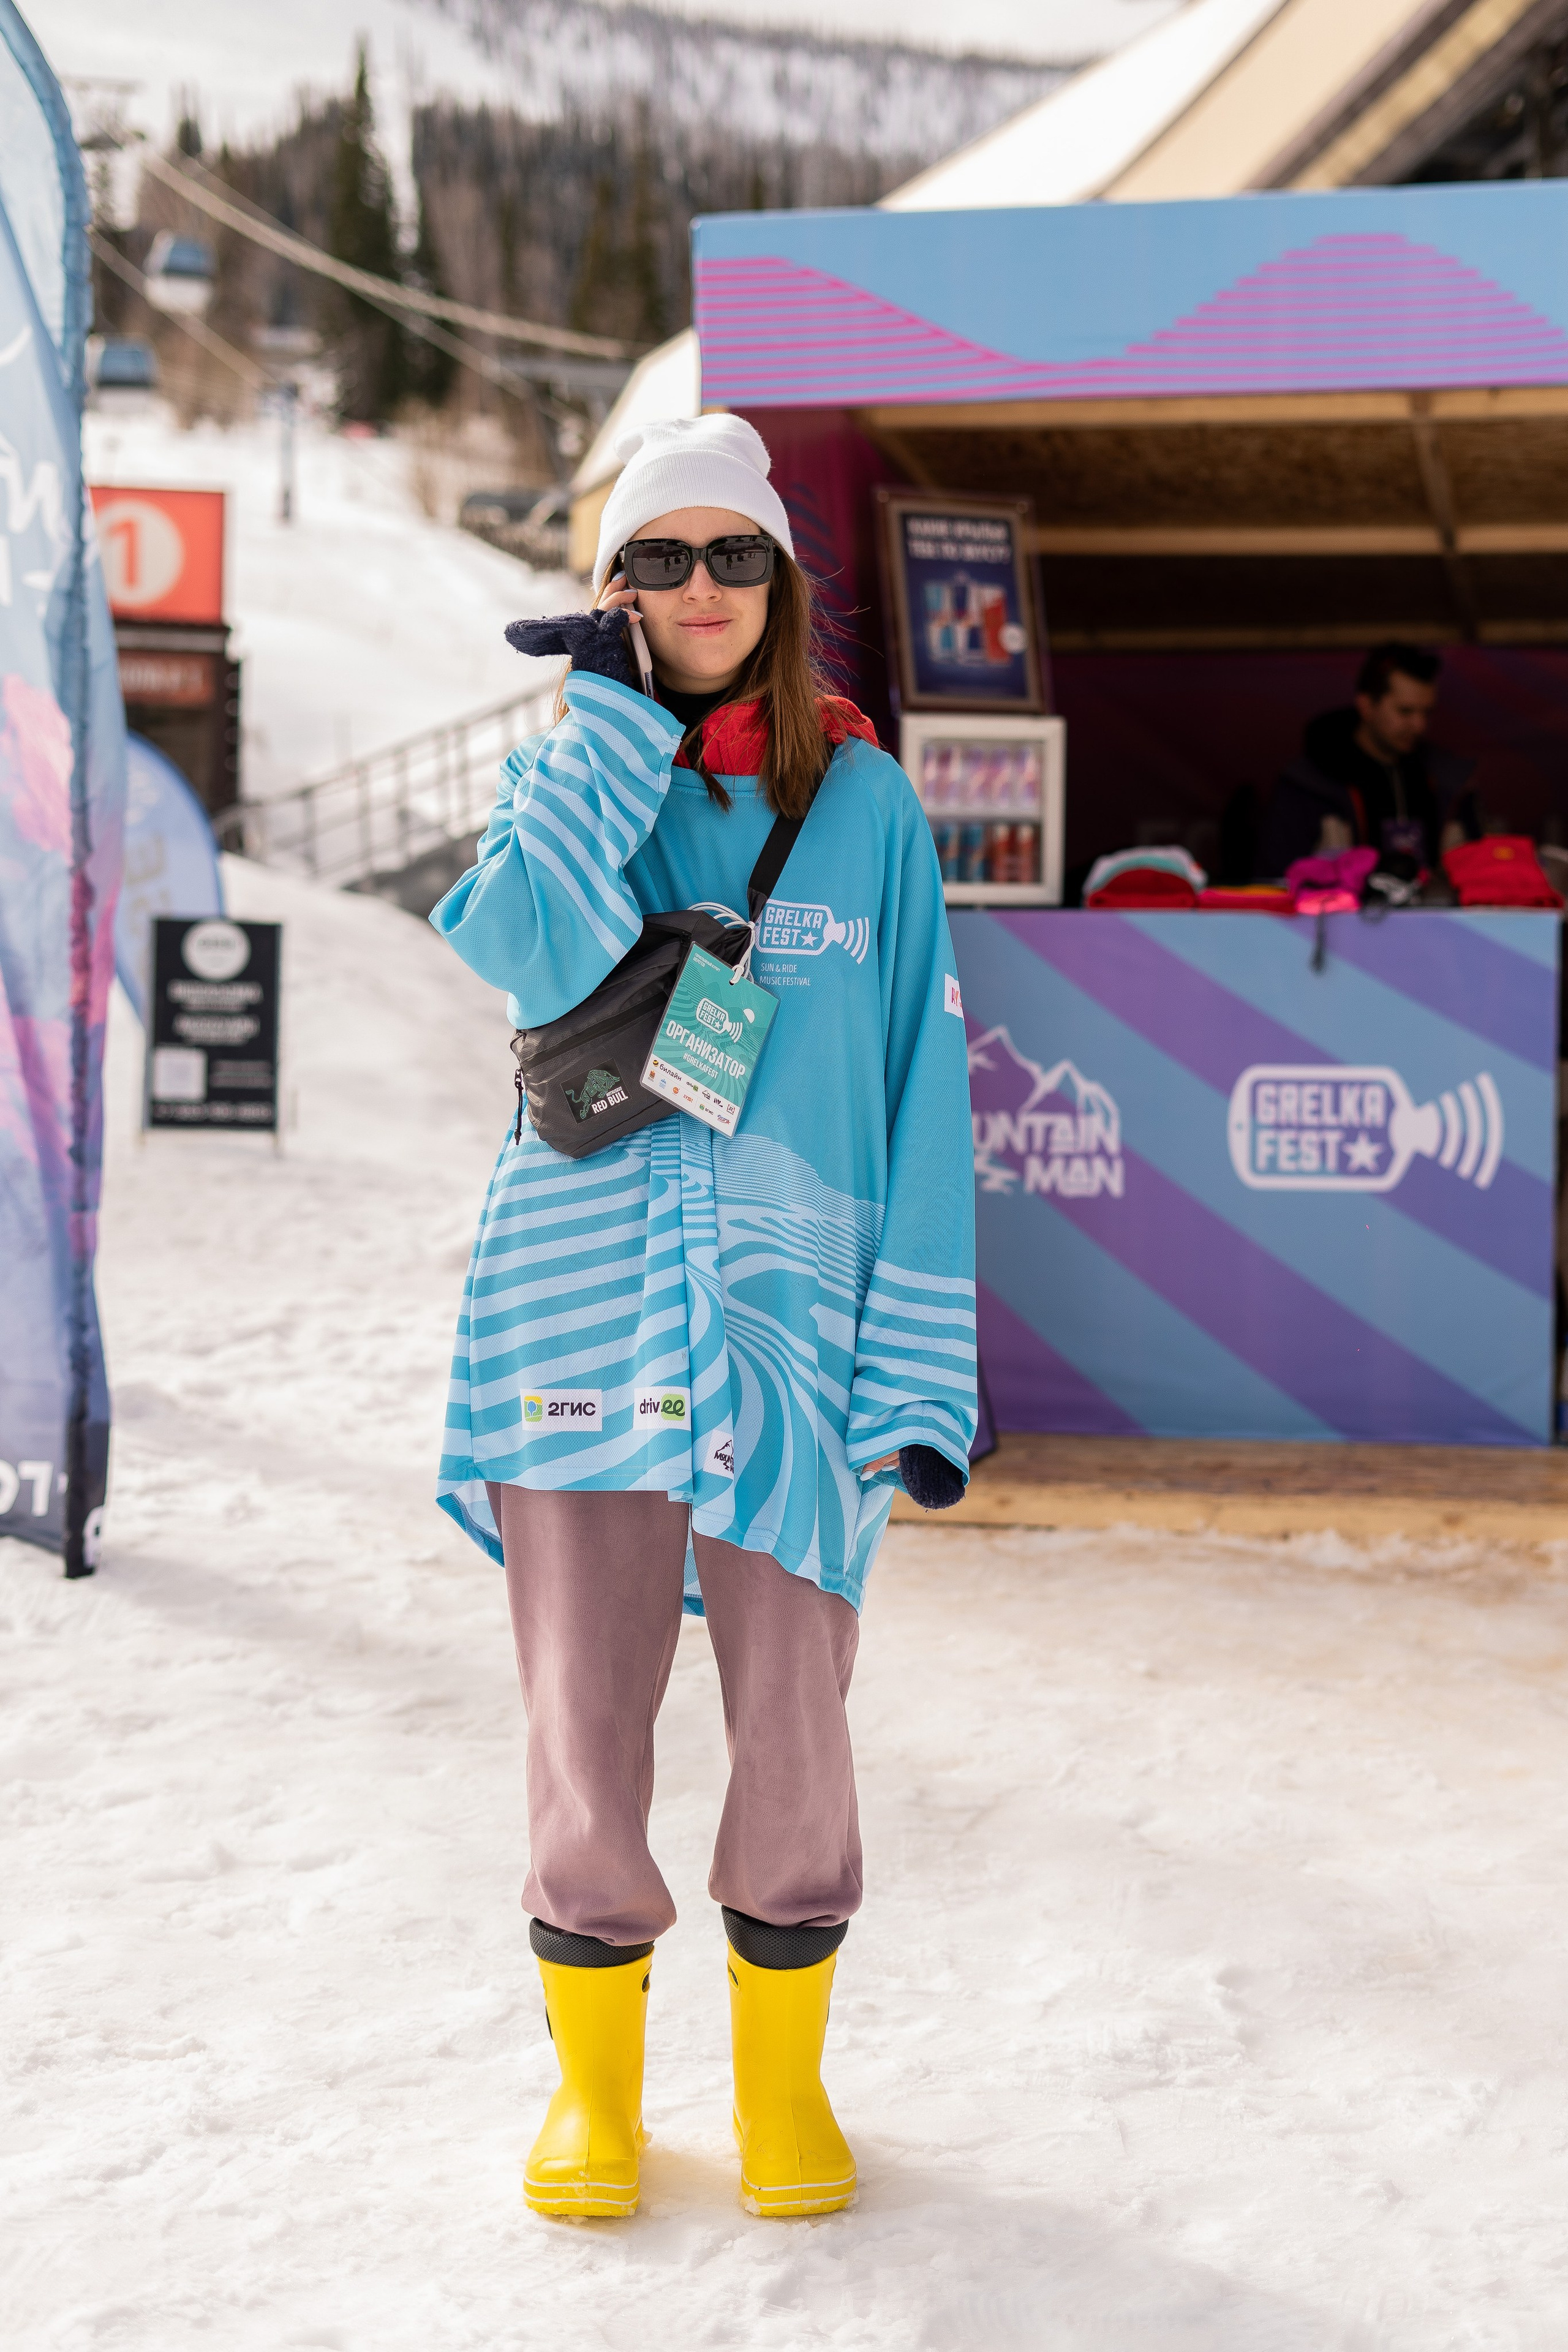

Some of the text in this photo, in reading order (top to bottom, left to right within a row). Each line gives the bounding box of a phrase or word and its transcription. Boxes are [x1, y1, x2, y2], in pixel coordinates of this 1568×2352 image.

[107, 521, 136, 589] 1
[764, 906, 823, 929] GRELKA
[763, 926, 802, 946] FEST
[761, 963, 797, 973] SUN & RIDE
[760, 976, 811, 986] MUSIC FESTIVAL
[699, 1010, 716, 1025] FEST
[703, 1001, 725, 1022] GRELKA
[666, 1020, 746, 1079] ОРГАНИЗАТОР
[659, 1063, 682, 1082] билайн
[683, 1052, 719, 1079] #GRELKAFEST
[591, 1099, 608, 1114] RED
[607, 1090, 628, 1106] BULL
[1255, 1083, 1387, 1128] GRELKA
[1256, 1128, 1345, 1172] FEST
[1024, 1154, 1125, 1198] MAN
[548, 1401, 596, 1417] 2ГИС
[639, 1398, 685, 1417] drivee
